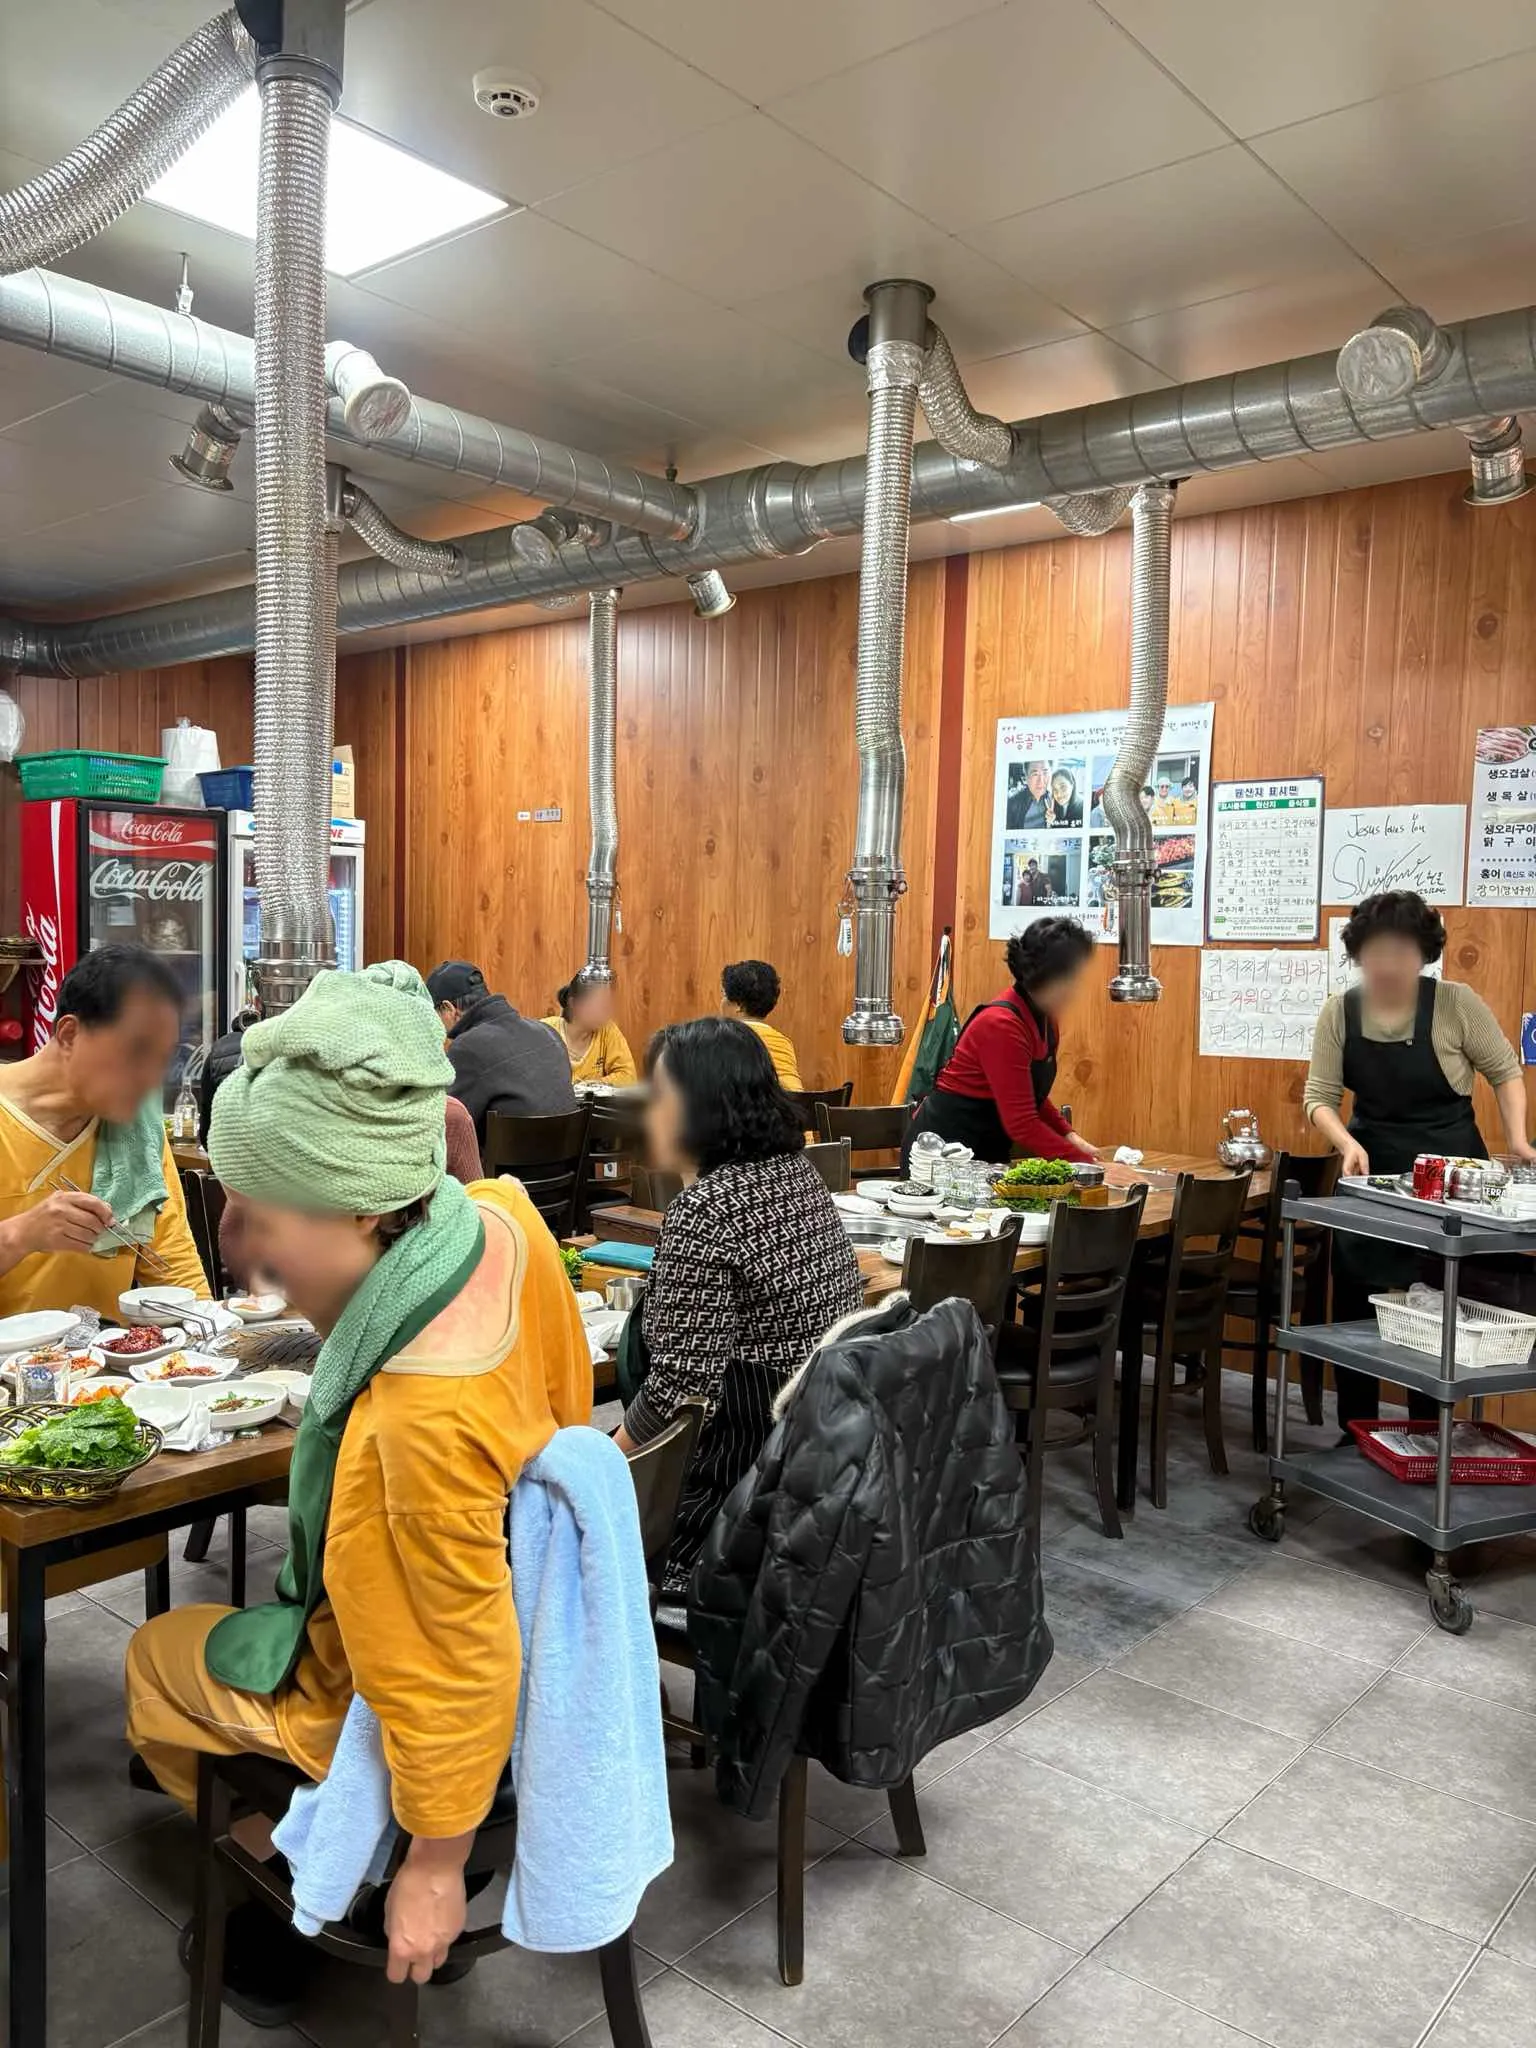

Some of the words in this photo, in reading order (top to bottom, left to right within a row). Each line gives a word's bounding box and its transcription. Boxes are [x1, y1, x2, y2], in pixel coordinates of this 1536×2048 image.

[1488, 768, 1530, 780] 생오겹살
[121, 819, 185, 842] Coca-Cola
[90, 859, 214, 901] Coca-Cola
[1480, 868, 1501, 879] 홍어
